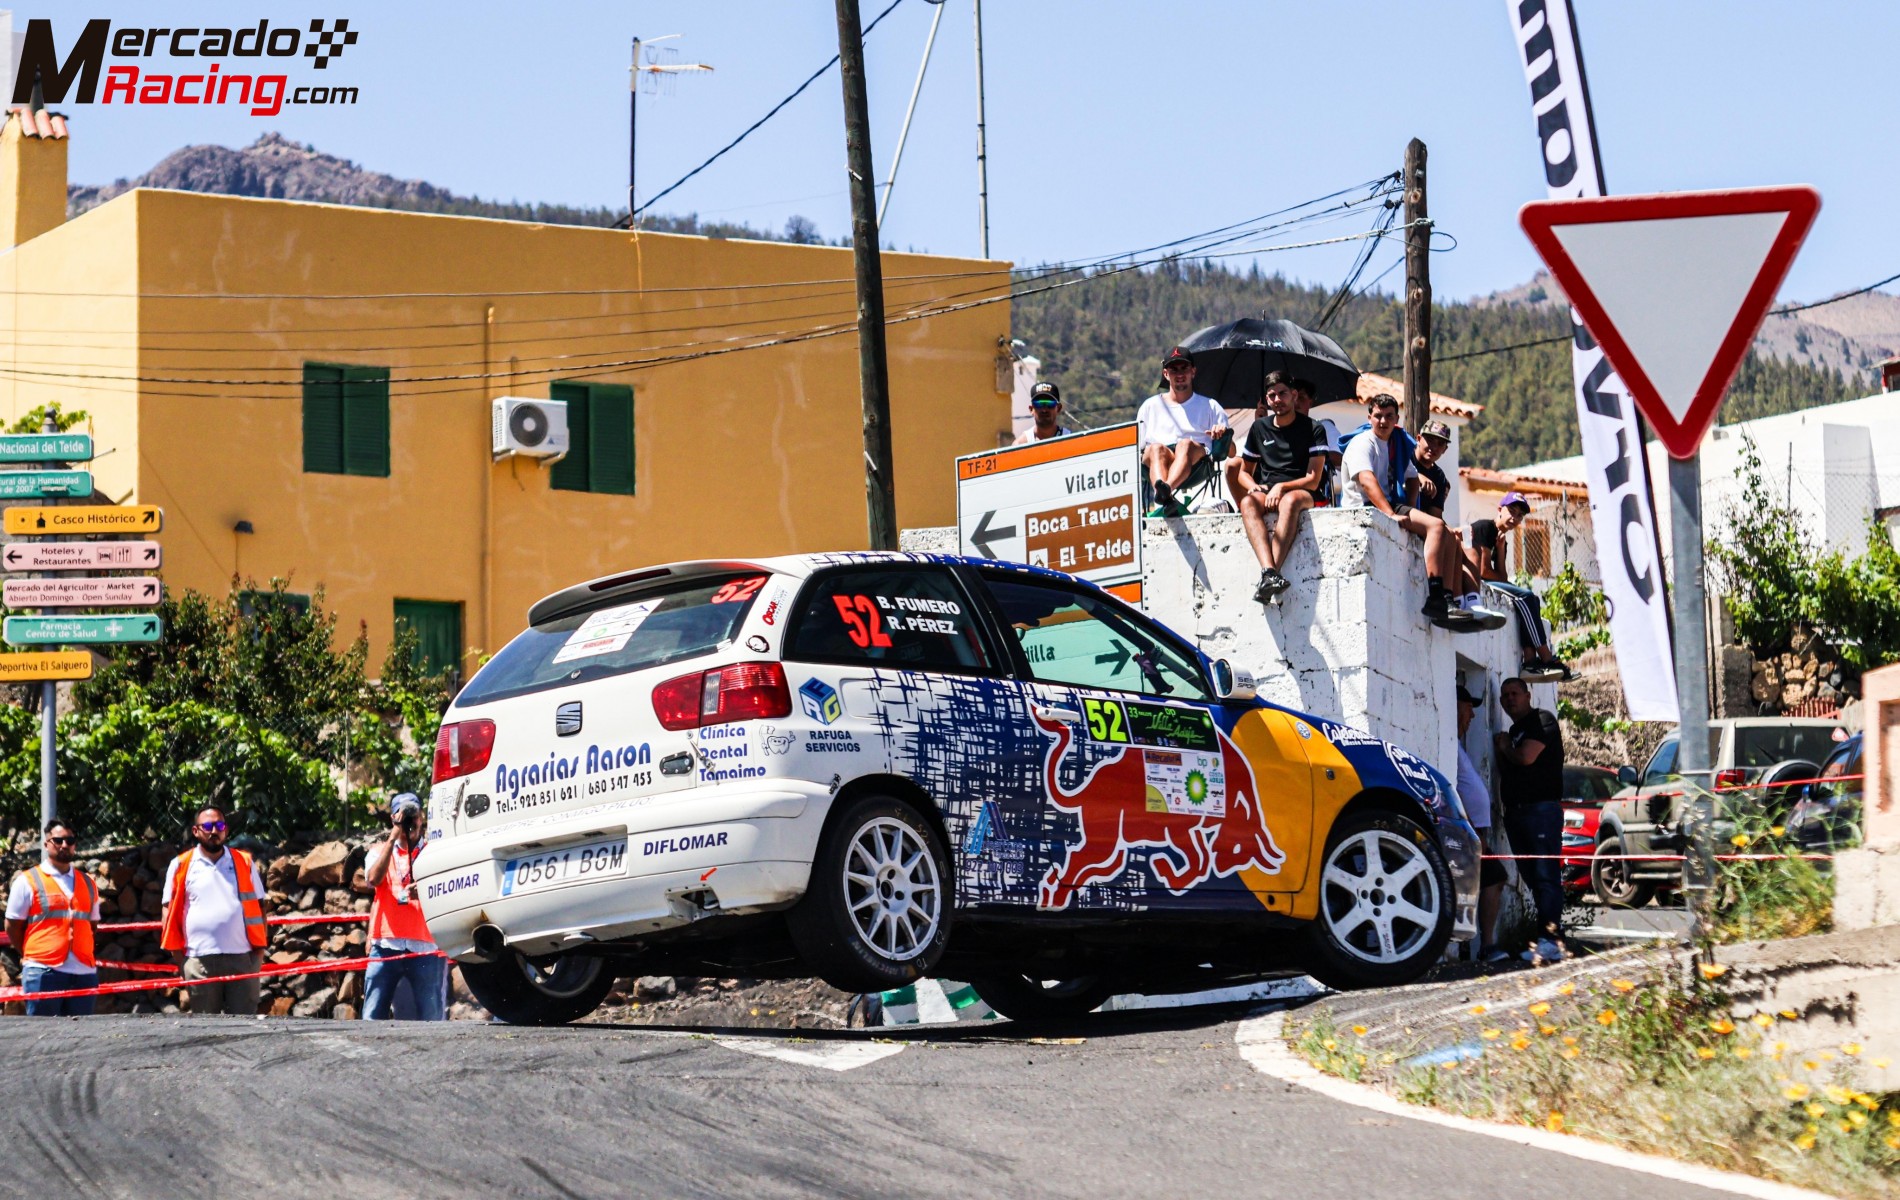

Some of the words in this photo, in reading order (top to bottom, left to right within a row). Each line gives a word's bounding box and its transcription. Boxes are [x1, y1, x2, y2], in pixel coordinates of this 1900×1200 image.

[0, 442, 39, 454] Nacional
[42, 441, 57, 453] del
[60, 441, 84, 452] Teide
[17, 477, 27, 485] de
[29, 476, 36, 485] la
[37, 475, 79, 485] Humanidad
[1065, 469, 1129, 494] Vilaflor
[16, 485, 34, 493] 2007
[53, 514, 84, 525] Casco
[87, 512, 136, 524] Histórico
[1028, 515, 1069, 537] Boca
[1077, 504, 1130, 527] Tauce
[41, 547, 75, 555] Hoteles
[78, 548, 83, 556] y
[1060, 547, 1077, 568] El
[1085, 539, 1131, 562] Teide
[33, 557, 91, 566] Restaurantes
[6, 584, 41, 592] Mercado
[43, 583, 56, 591] del
[58, 582, 98, 592] Agricultor
[106, 582, 135, 590] Market
[711, 576, 767, 604] 52
[8, 593, 38, 601] Abierto
[40, 592, 74, 602] Domingo
[82, 591, 103, 601] Open
[105, 591, 133, 601] Sunday
[876, 596, 896, 610] B.
[898, 598, 961, 615] FUMERO
[40, 622, 81, 631] Farmacia
[832, 595, 893, 648] 52
[886, 616, 905, 630] R.
[906, 615, 958, 635] PÉREZ
[26, 630, 56, 639] Centro
[58, 630, 70, 638] de
[72, 629, 97, 638] Salud
[40, 661, 49, 671] El
[51, 660, 89, 672] Salguero
[1084, 699, 1128, 742] 52
[700, 723, 745, 740] Clínica
[810, 731, 852, 740] RAFUGA
[700, 743, 747, 759] Dental
[805, 742, 861, 752] SERVICIOS
[496, 751, 579, 799] Agrarias
[586, 742, 651, 774] Aaron
[699, 763, 766, 781] Tamaimo
[519, 792, 537, 809] 922
[540, 788, 556, 805] 851
[560, 784, 578, 801] 621
[588, 779, 607, 795] 680
[610, 774, 628, 791] 347
[643, 831, 728, 856] DIFLOMAR
[516, 853, 571, 886] 0561
[579, 844, 625, 873] BGM
[428, 873, 479, 899] DIFLOMAR
